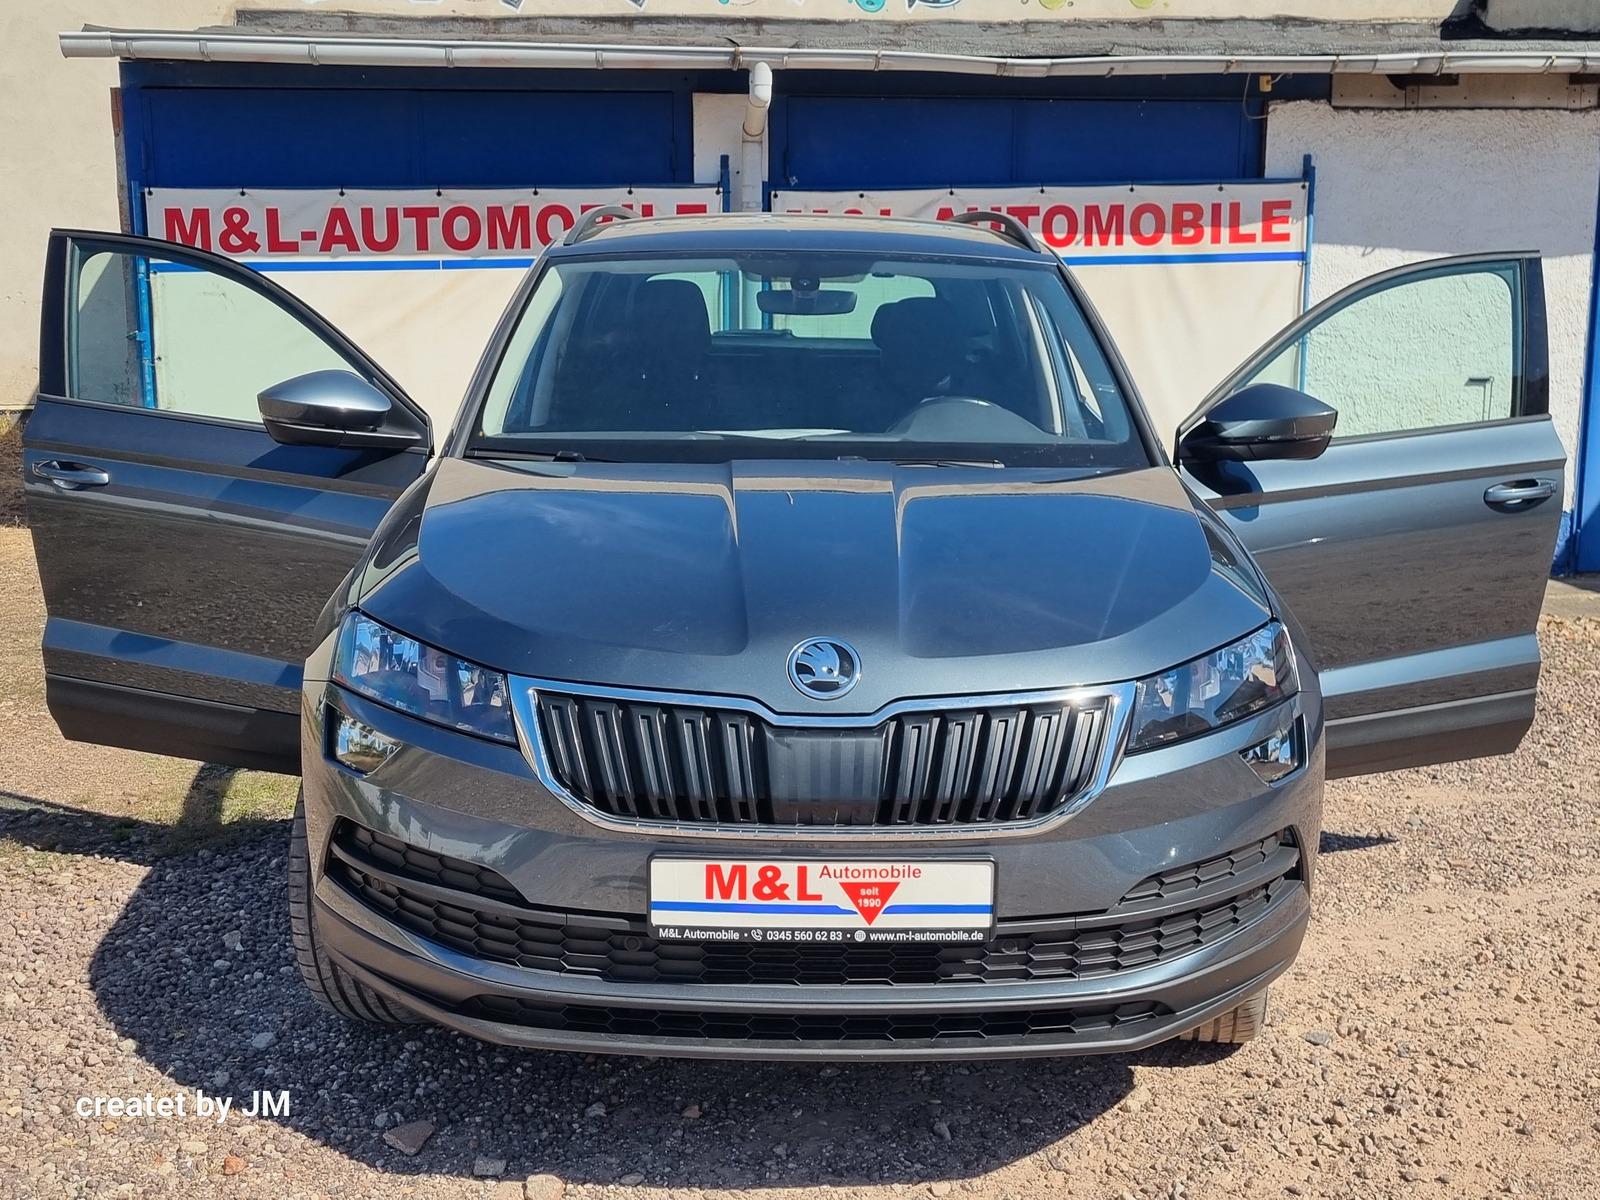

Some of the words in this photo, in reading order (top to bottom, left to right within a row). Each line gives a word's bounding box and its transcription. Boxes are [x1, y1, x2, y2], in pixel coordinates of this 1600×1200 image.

[164, 204, 707, 253] M&L-AUTOMO
[705, 864, 823, 901] M&L
[819, 865, 922, 879] Automobile
[857, 898, 881, 908] 1990
[658, 928, 682, 938] M&L
[683, 929, 740, 940] Automobile
[766, 930, 792, 941] 0345
[794, 931, 812, 941] 560
[815, 931, 828, 941] 62
[829, 931, 843, 941] 83
[869, 931, 984, 941] www.m-l-automobile.de
